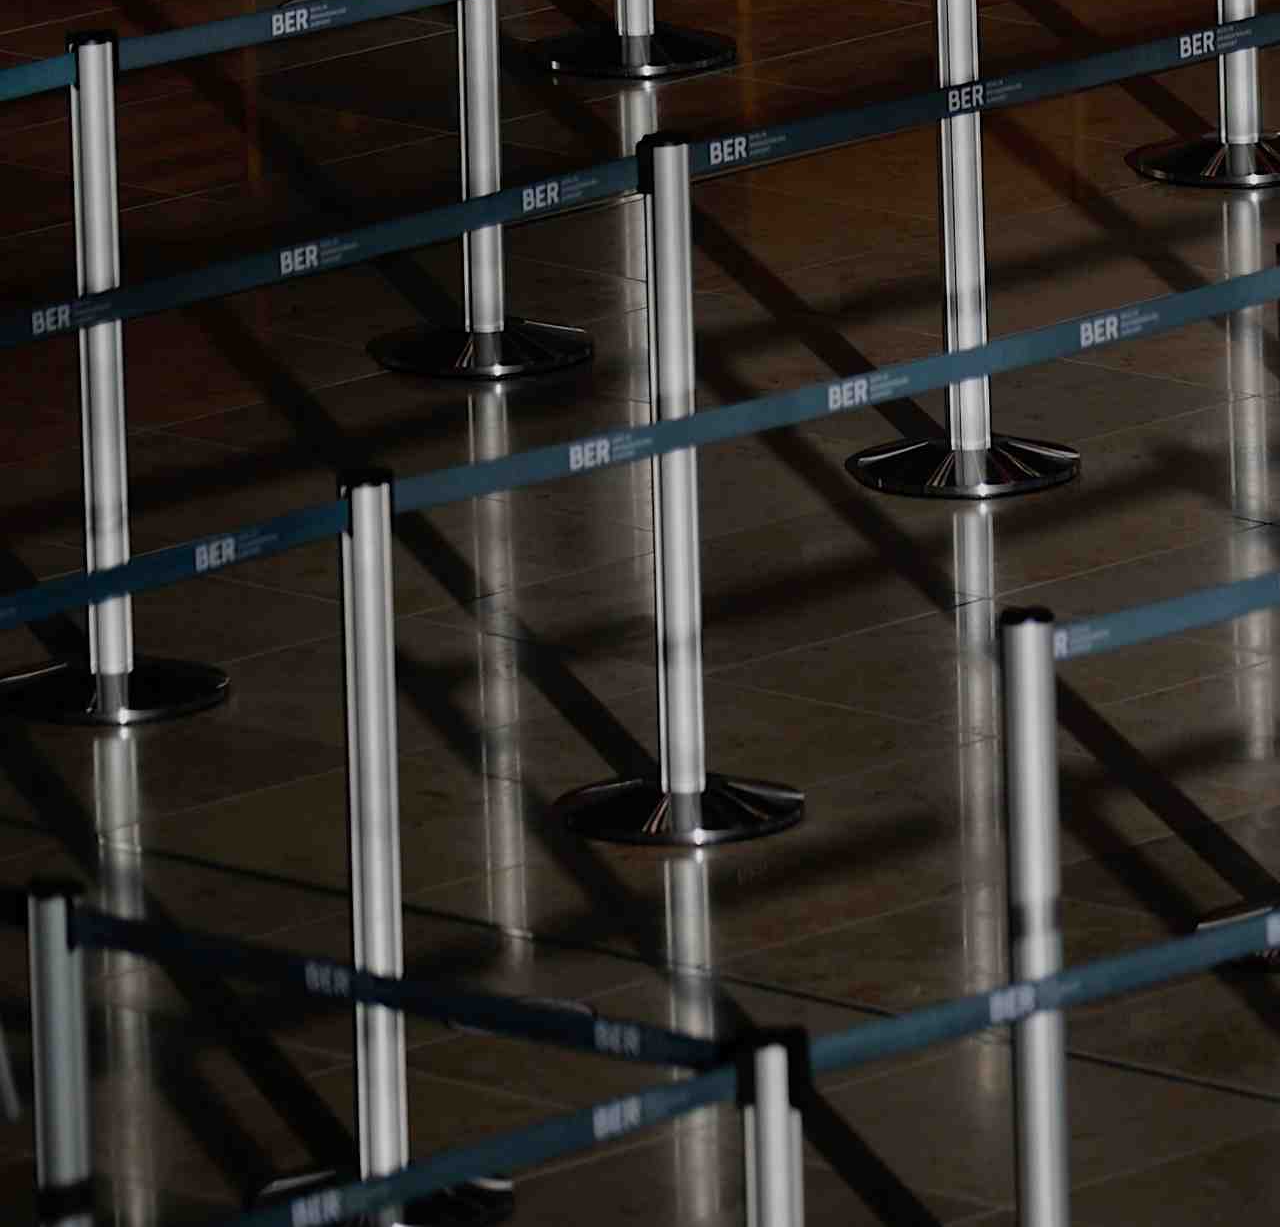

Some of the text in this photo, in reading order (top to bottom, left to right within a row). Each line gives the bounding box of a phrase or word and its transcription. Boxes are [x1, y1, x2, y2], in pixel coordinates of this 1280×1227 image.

[272, 9, 308, 36] BER
[1179, 30, 1215, 58] BER
[948, 83, 983, 111] BER
[710, 135, 747, 163] BER
[522, 181, 559, 211] BER
[280, 244, 318, 275] BER
[32, 305, 70, 335] BER
[1080, 317, 1119, 347] BER
[828, 379, 868, 409] BER
[569, 439, 609, 470] BER
[194, 535, 235, 570] BER
